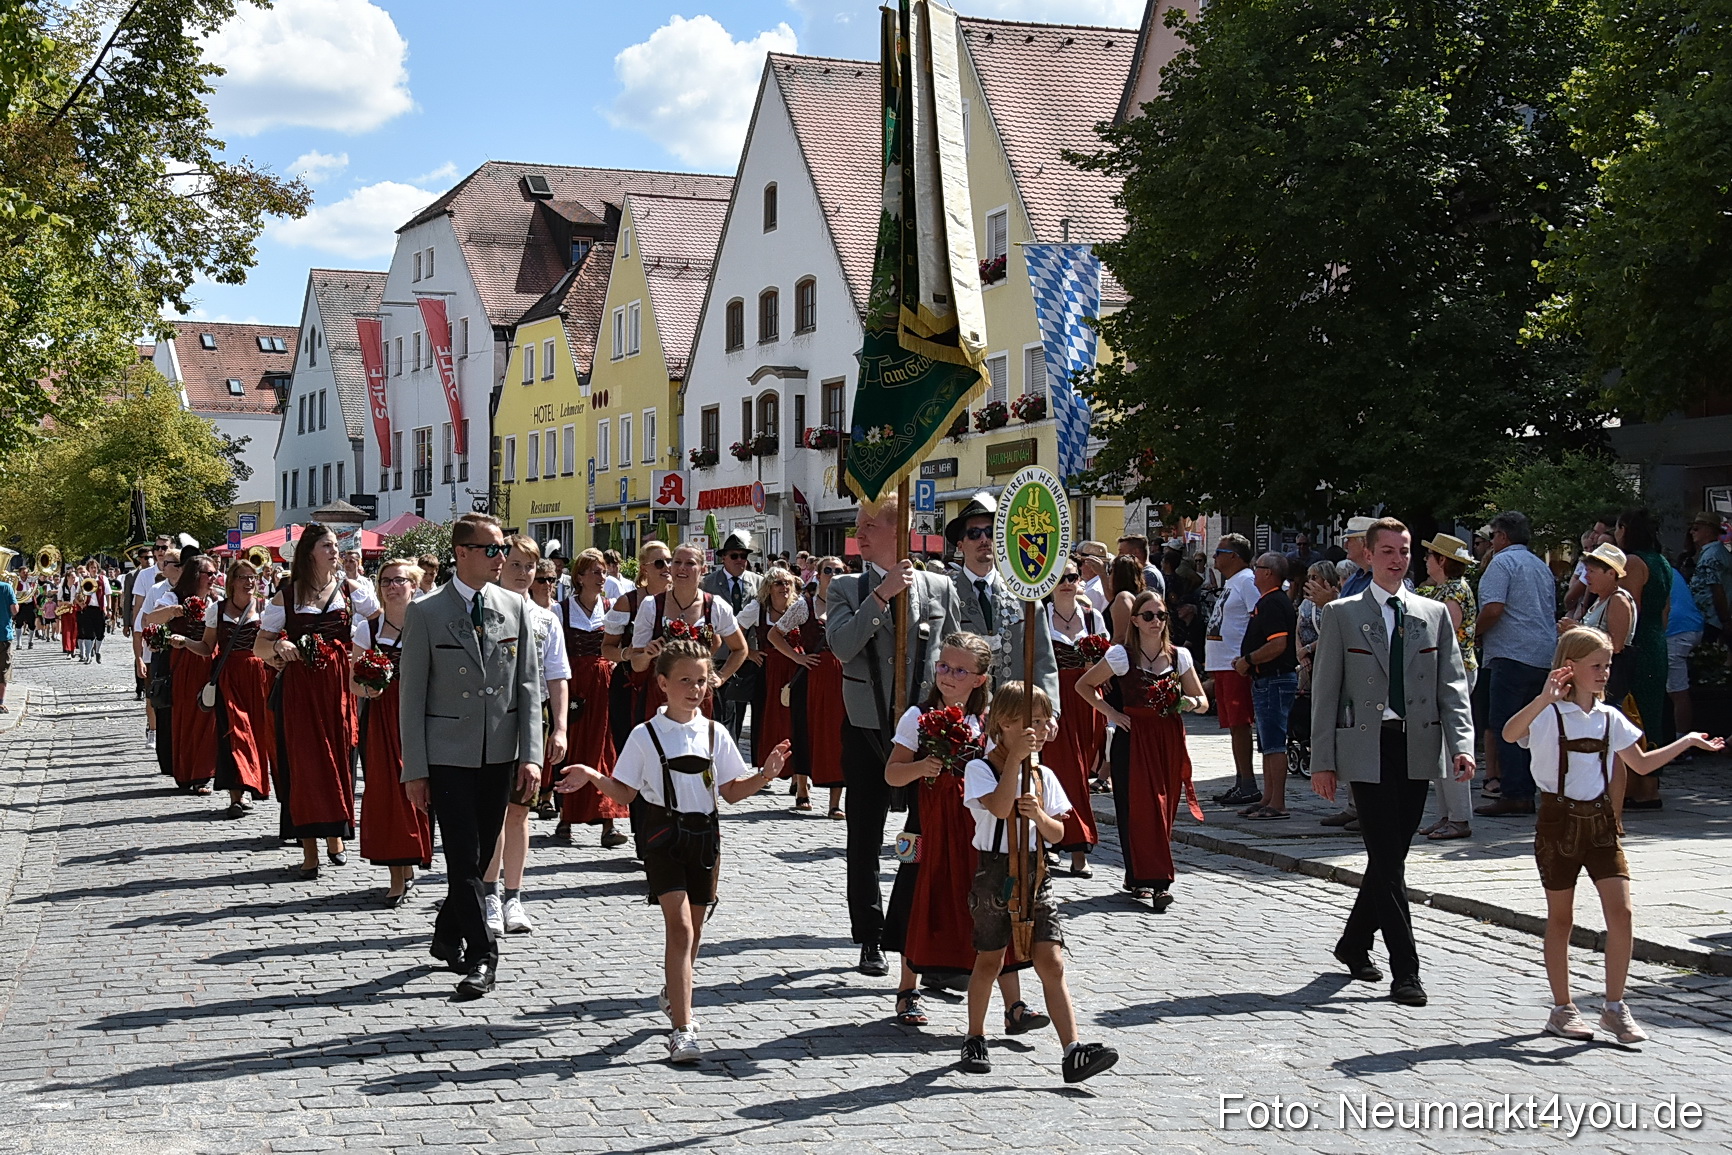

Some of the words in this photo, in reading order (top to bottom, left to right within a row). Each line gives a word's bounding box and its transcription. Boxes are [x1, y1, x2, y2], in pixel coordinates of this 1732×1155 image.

[884, 368, 908, 383] am
[370, 368, 388, 419] SALE
[533, 403, 555, 424] HOTEL
[560, 400, 584, 417] Lehmeier
[622, 481, 626, 502] P
[919, 483, 931, 508] P
[530, 500, 561, 514] Restaurant
[1006, 573, 1058, 598] HOLZHEIM
